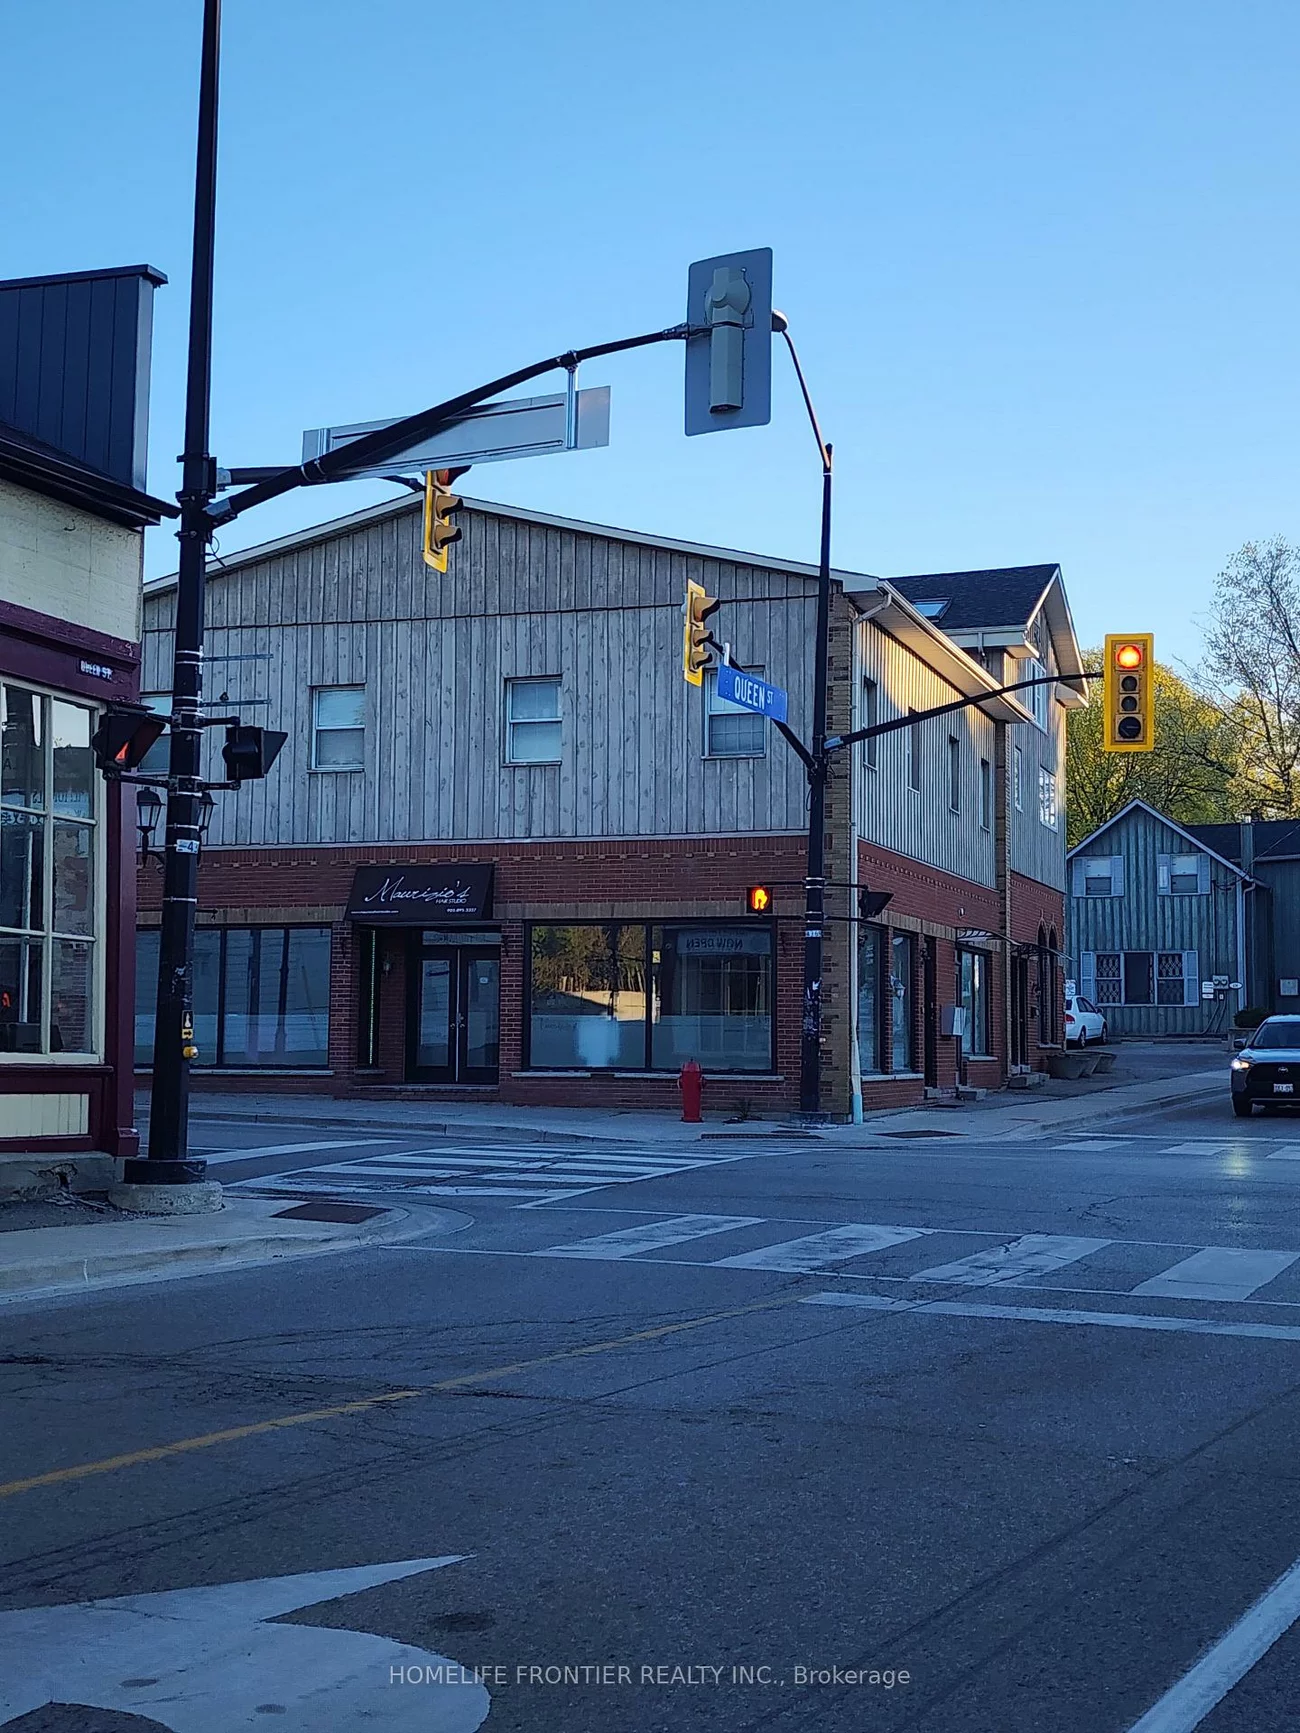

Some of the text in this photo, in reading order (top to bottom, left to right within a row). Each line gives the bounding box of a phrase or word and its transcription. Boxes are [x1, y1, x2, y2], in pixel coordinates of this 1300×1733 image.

[734, 675, 774, 710] QUEEN ST
[364, 875, 471, 902] Maurizio's
